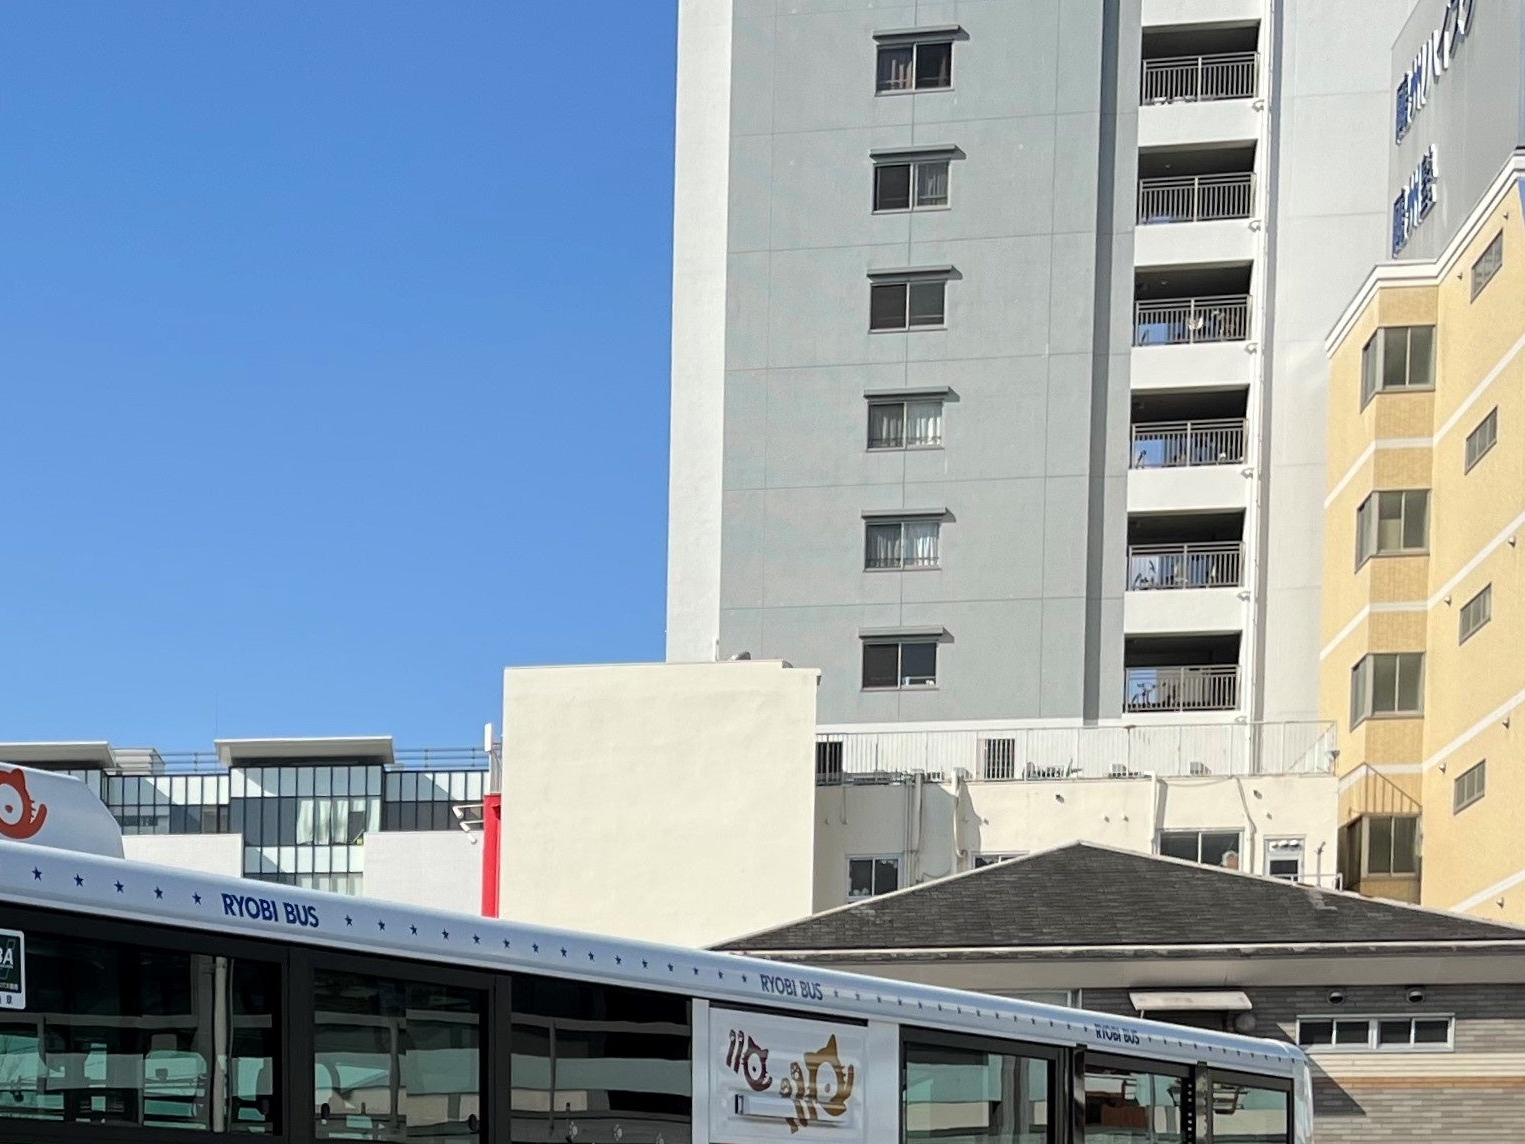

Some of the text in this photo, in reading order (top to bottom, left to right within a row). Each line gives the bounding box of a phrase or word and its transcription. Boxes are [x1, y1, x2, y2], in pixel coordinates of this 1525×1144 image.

[221, 893, 319, 928] RYOBI BUS
[759, 973, 823, 1001] RYOBI BUS
